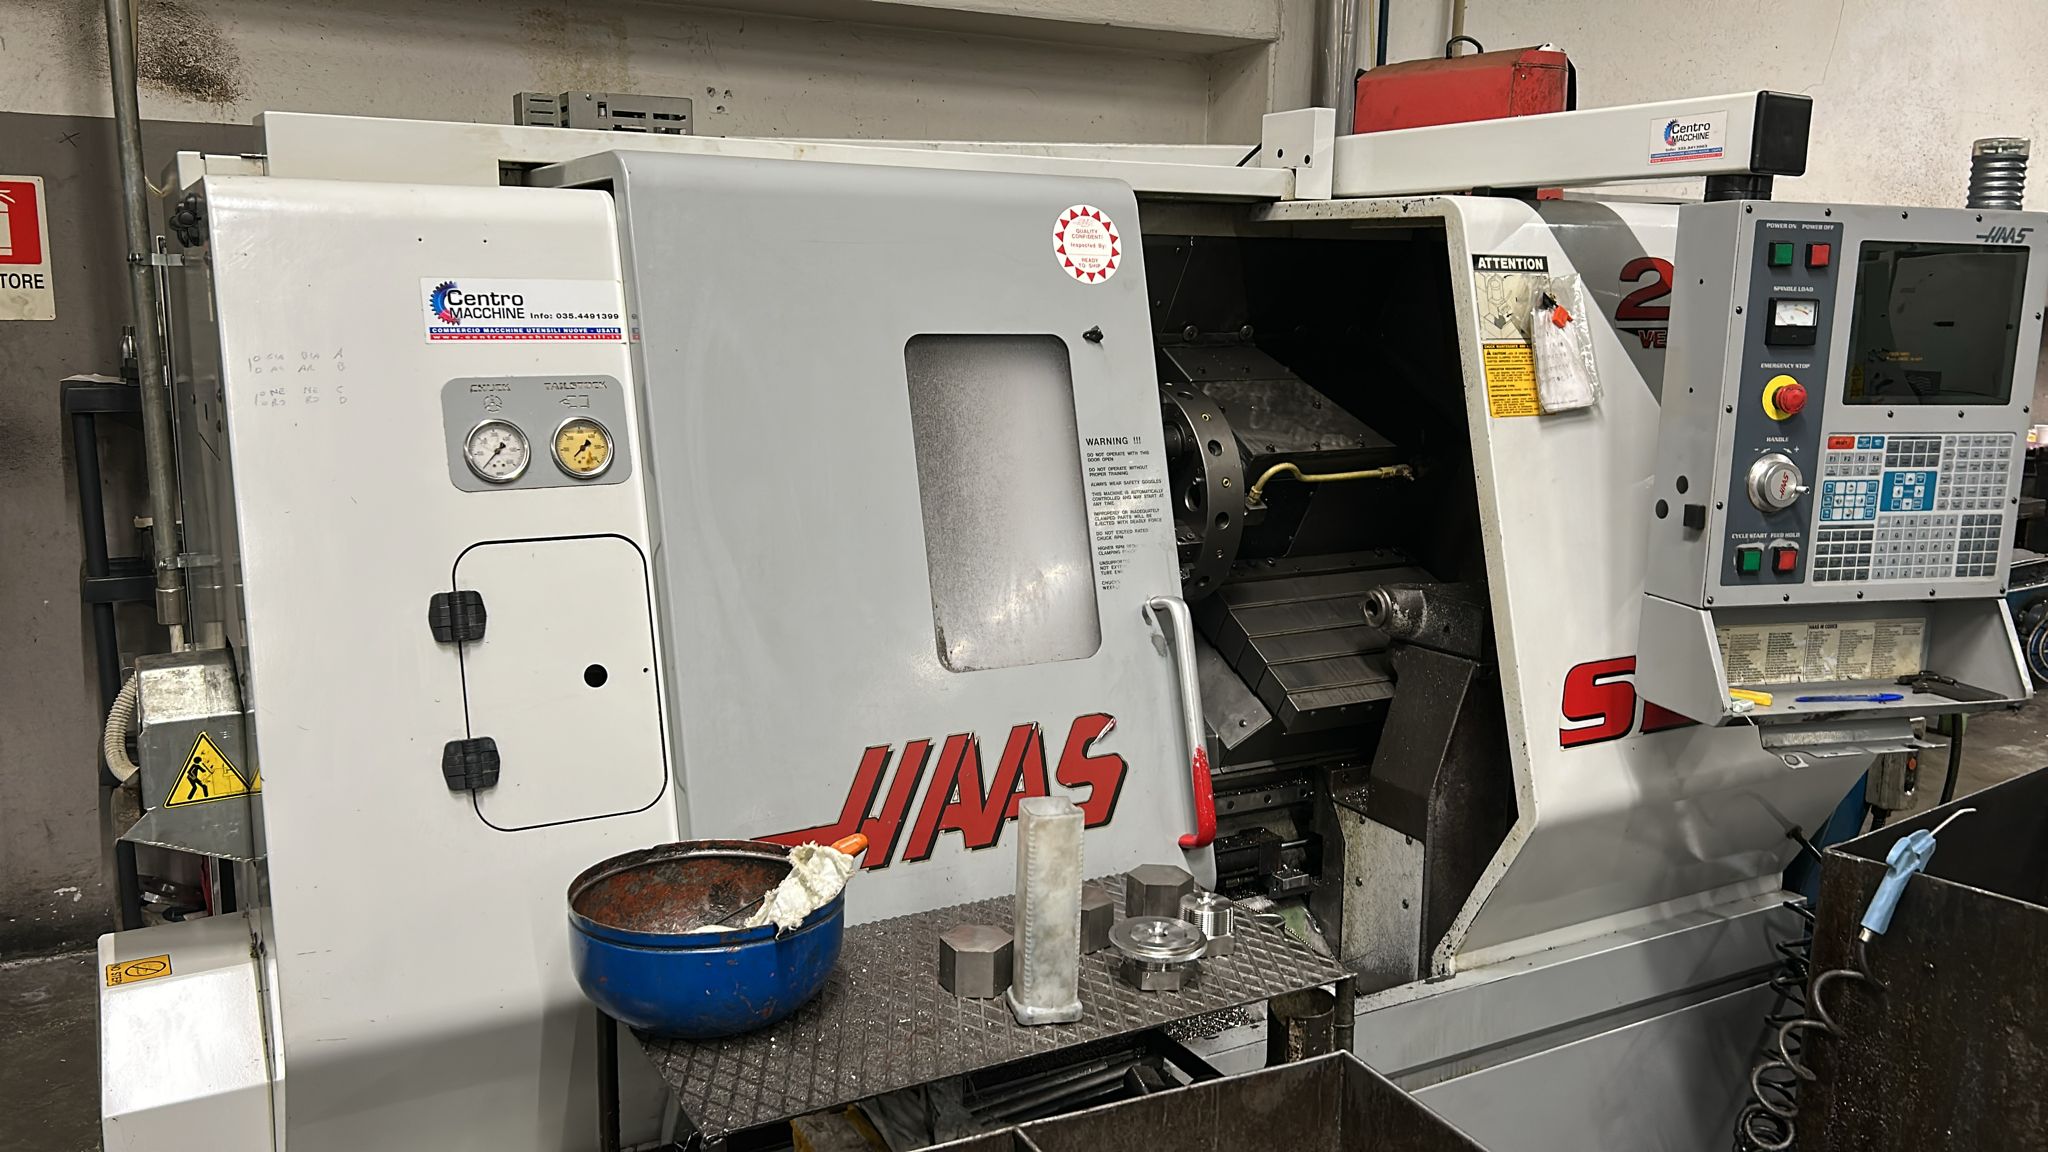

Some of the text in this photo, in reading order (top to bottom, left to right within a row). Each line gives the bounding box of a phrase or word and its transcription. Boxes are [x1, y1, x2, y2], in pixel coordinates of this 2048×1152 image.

[1671, 122, 1711, 135] Centro
[1671, 131, 1710, 143] MACCHINE
[1976, 226, 2034, 244] HAAS
[1478, 256, 1544, 271] ATTENTION
[447, 289, 524, 307] Centro
[450, 307, 525, 320] MACCHINE
[470, 384, 511, 392] CHUCK
[544, 381, 608, 390] TAILSTOCK
[1086, 436, 1141, 446] WARNING !!!
[1780, 472, 1789, 498] HAAS
[752, 712, 1130, 872] HAAS
